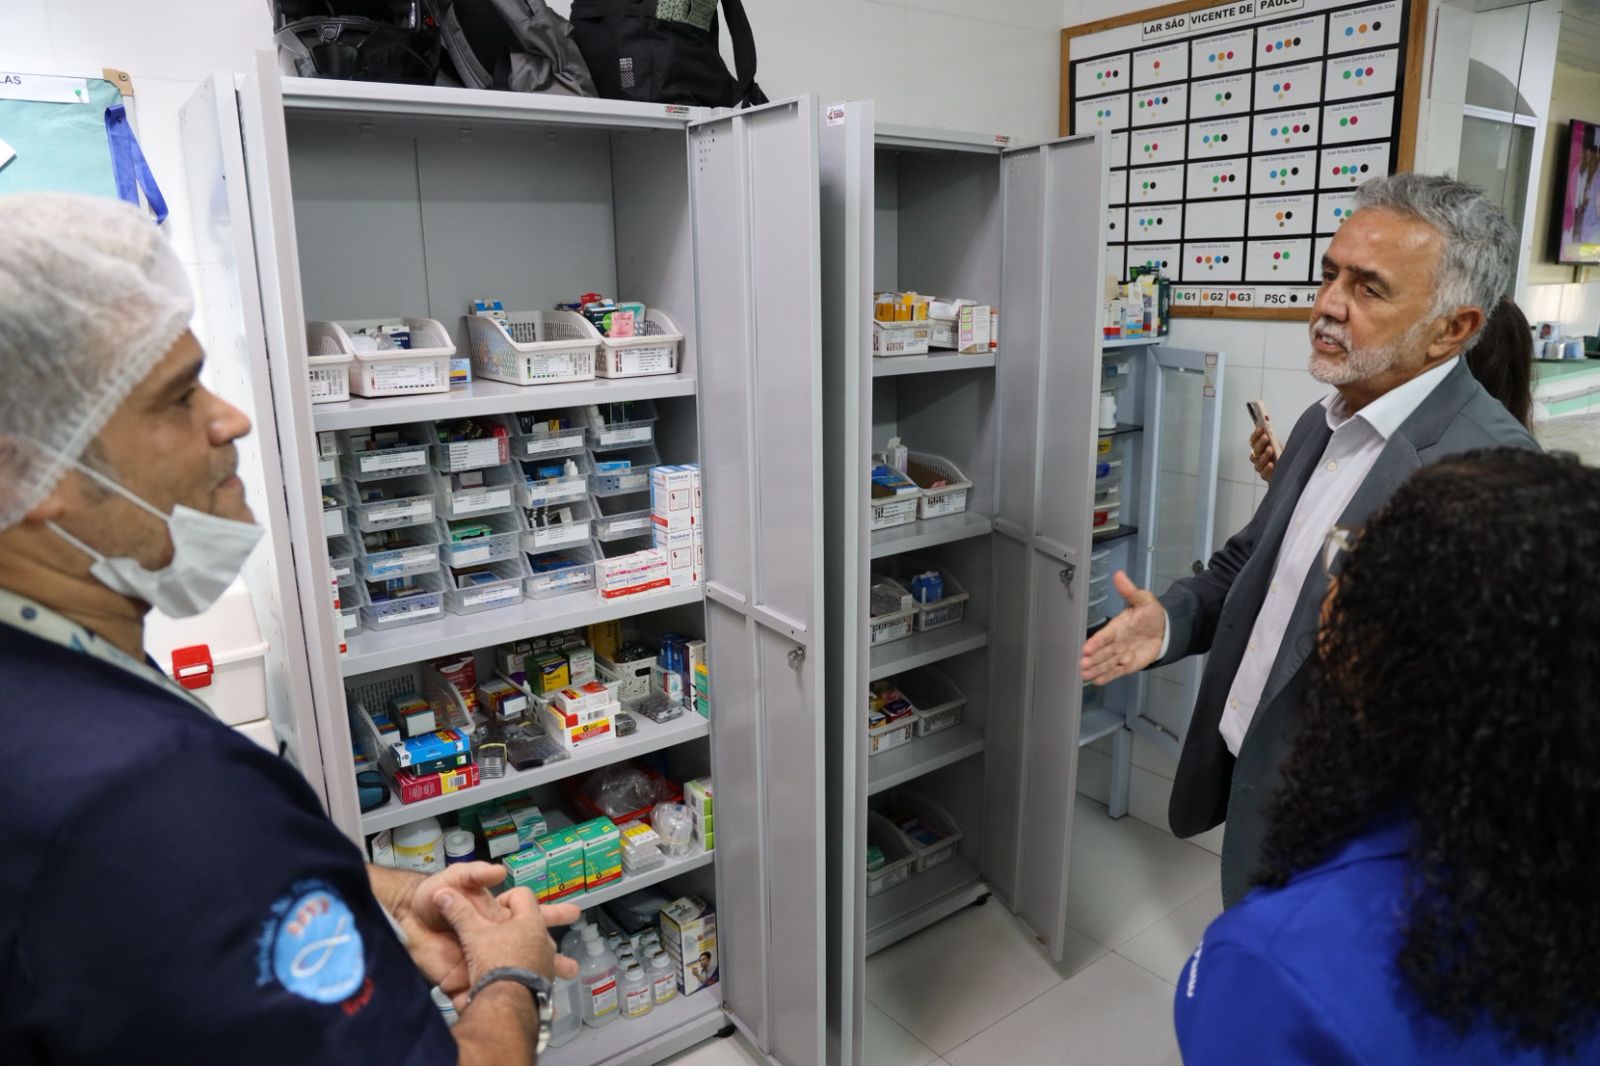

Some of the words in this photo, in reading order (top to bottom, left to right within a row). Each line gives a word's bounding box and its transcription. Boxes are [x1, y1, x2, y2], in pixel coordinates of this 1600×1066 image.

[1144, 22, 1162, 34] LAR
[1165, 18, 1185, 31] SÃO
[1190, 8, 1236, 24] VICENTE
[1239, 4, 1253, 14] DE
[1238, 293, 1251, 301] G3
[1264, 294, 1286, 303] PSC
